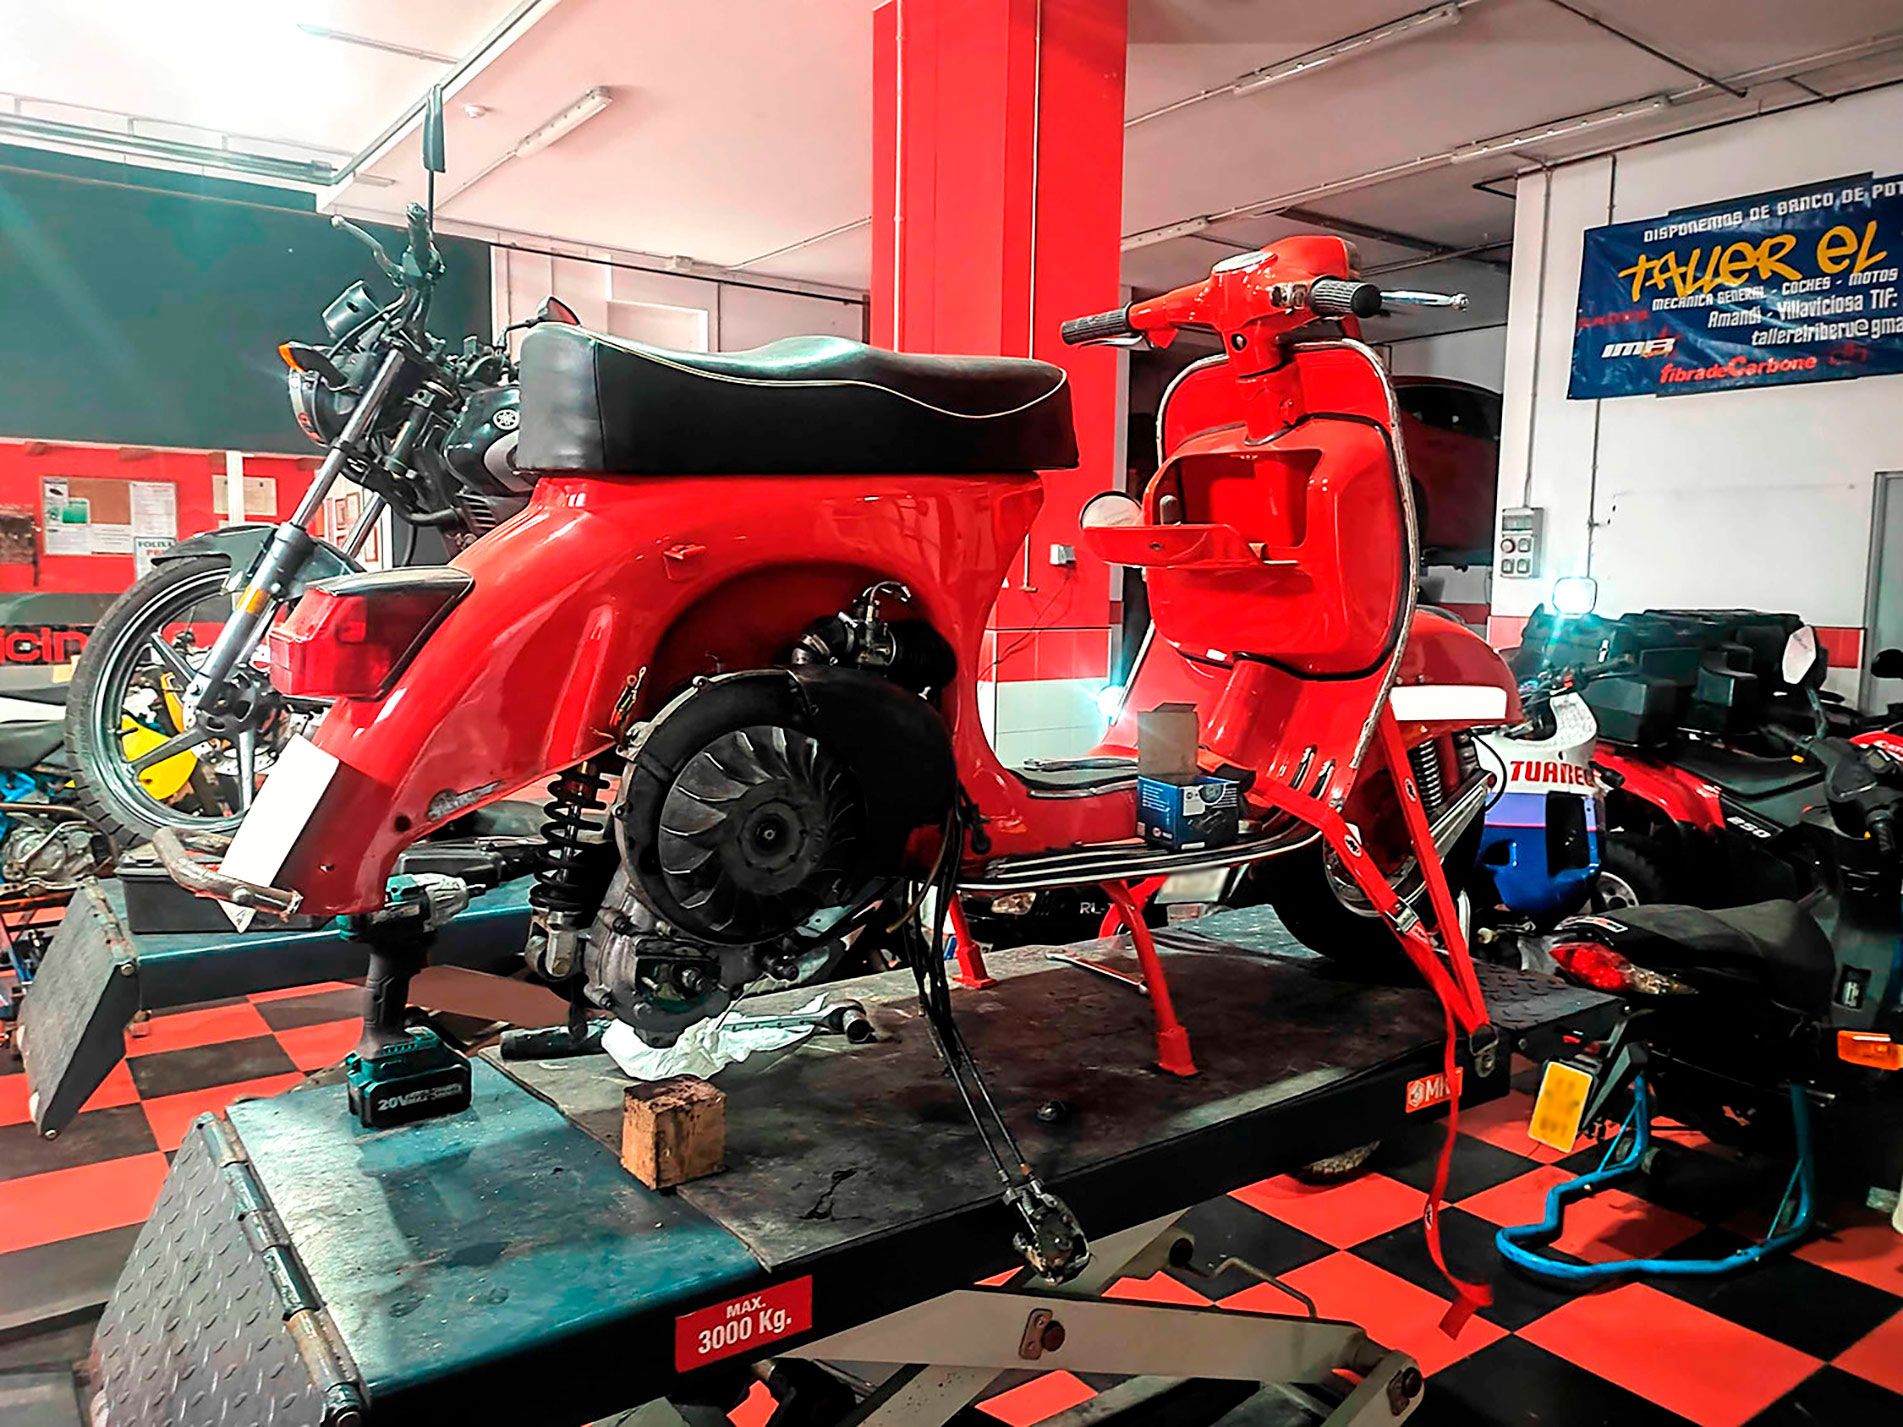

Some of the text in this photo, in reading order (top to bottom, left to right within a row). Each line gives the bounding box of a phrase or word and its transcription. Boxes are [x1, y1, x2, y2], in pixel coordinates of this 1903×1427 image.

[1643, 210, 1743, 243] DISPONEMOS
[1749, 204, 1770, 222] DE
[1777, 192, 1834, 217] BANCO
[1841, 186, 1864, 204] DE
[1717, 285, 1767, 305] GENERAL
[1782, 276, 1831, 296] COCHES
[1848, 267, 1899, 286] MOTOS
[1776, 294, 1864, 321] Villaviciosa
[1080, 902, 1113, 914] RL-
[726, 1296, 767, 1319] MAX.
[697, 1308, 792, 1354] 3000 Kg.
